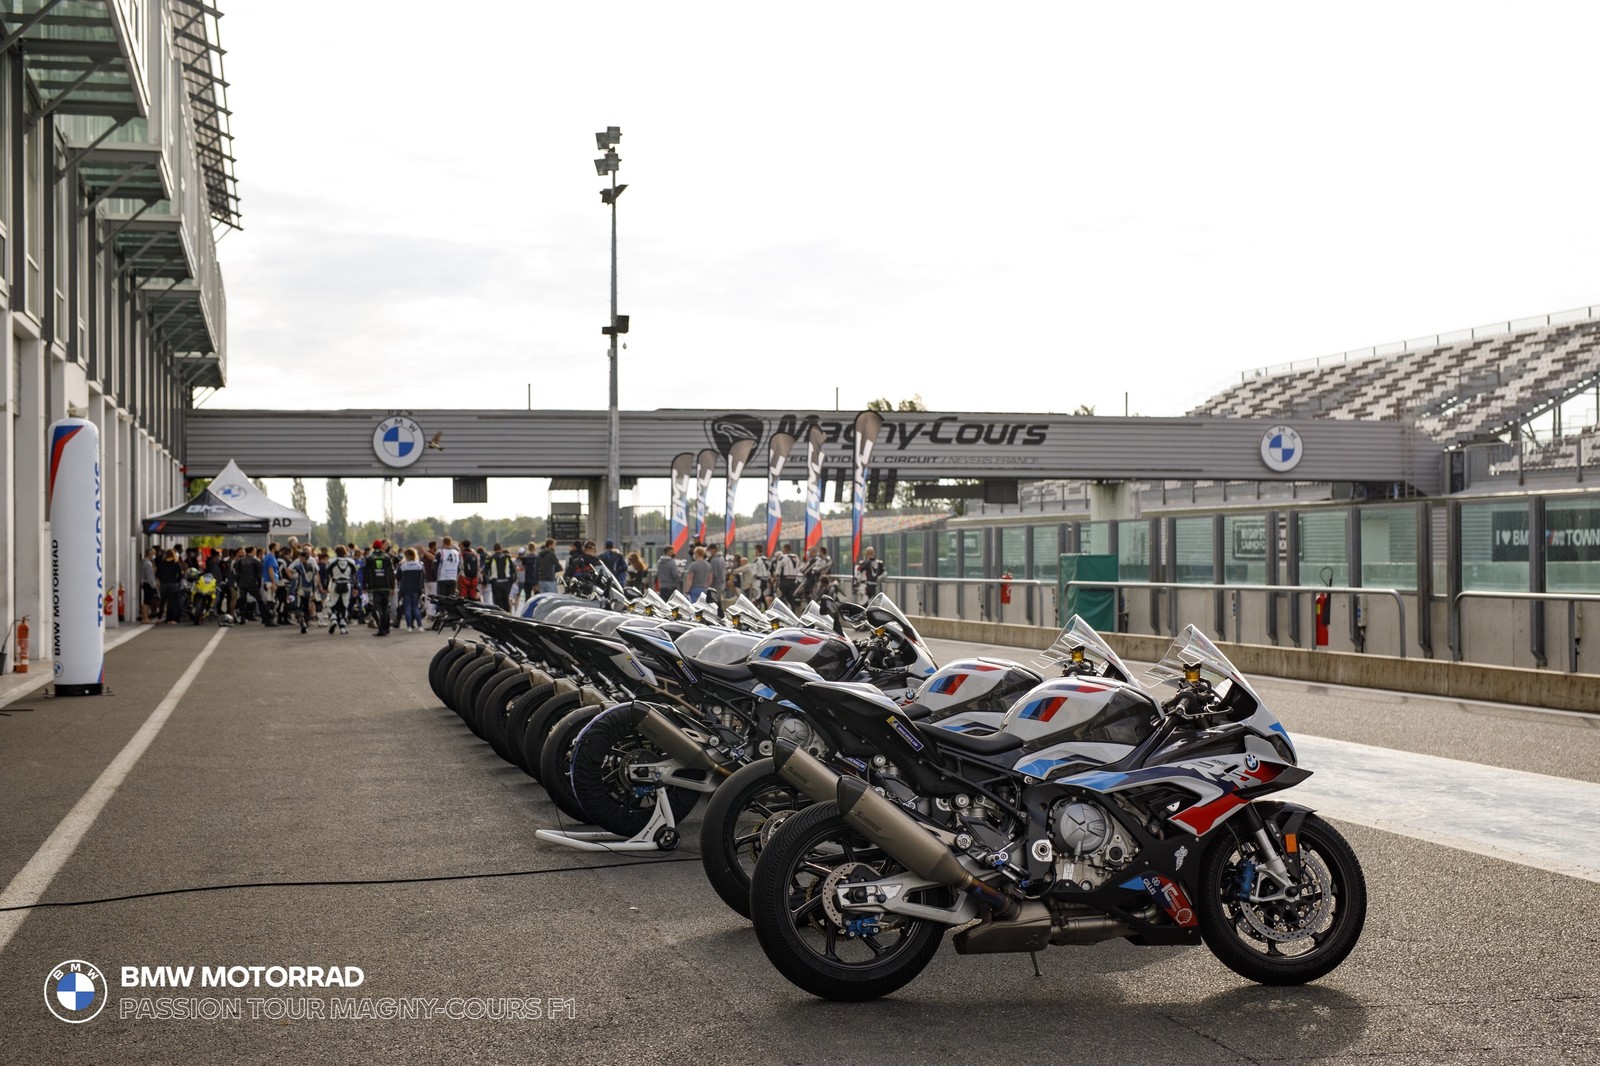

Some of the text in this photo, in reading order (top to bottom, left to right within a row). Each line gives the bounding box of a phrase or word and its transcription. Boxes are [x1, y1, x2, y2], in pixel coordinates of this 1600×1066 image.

[380, 418, 418, 432] BMW
[883, 455, 938, 463] CIRCUIT
[269, 518, 292, 528] AD
[446, 553, 458, 564] 41
[52, 539, 61, 656] BMW MOTORRAD
[1142, 878, 1157, 895] GILLES
